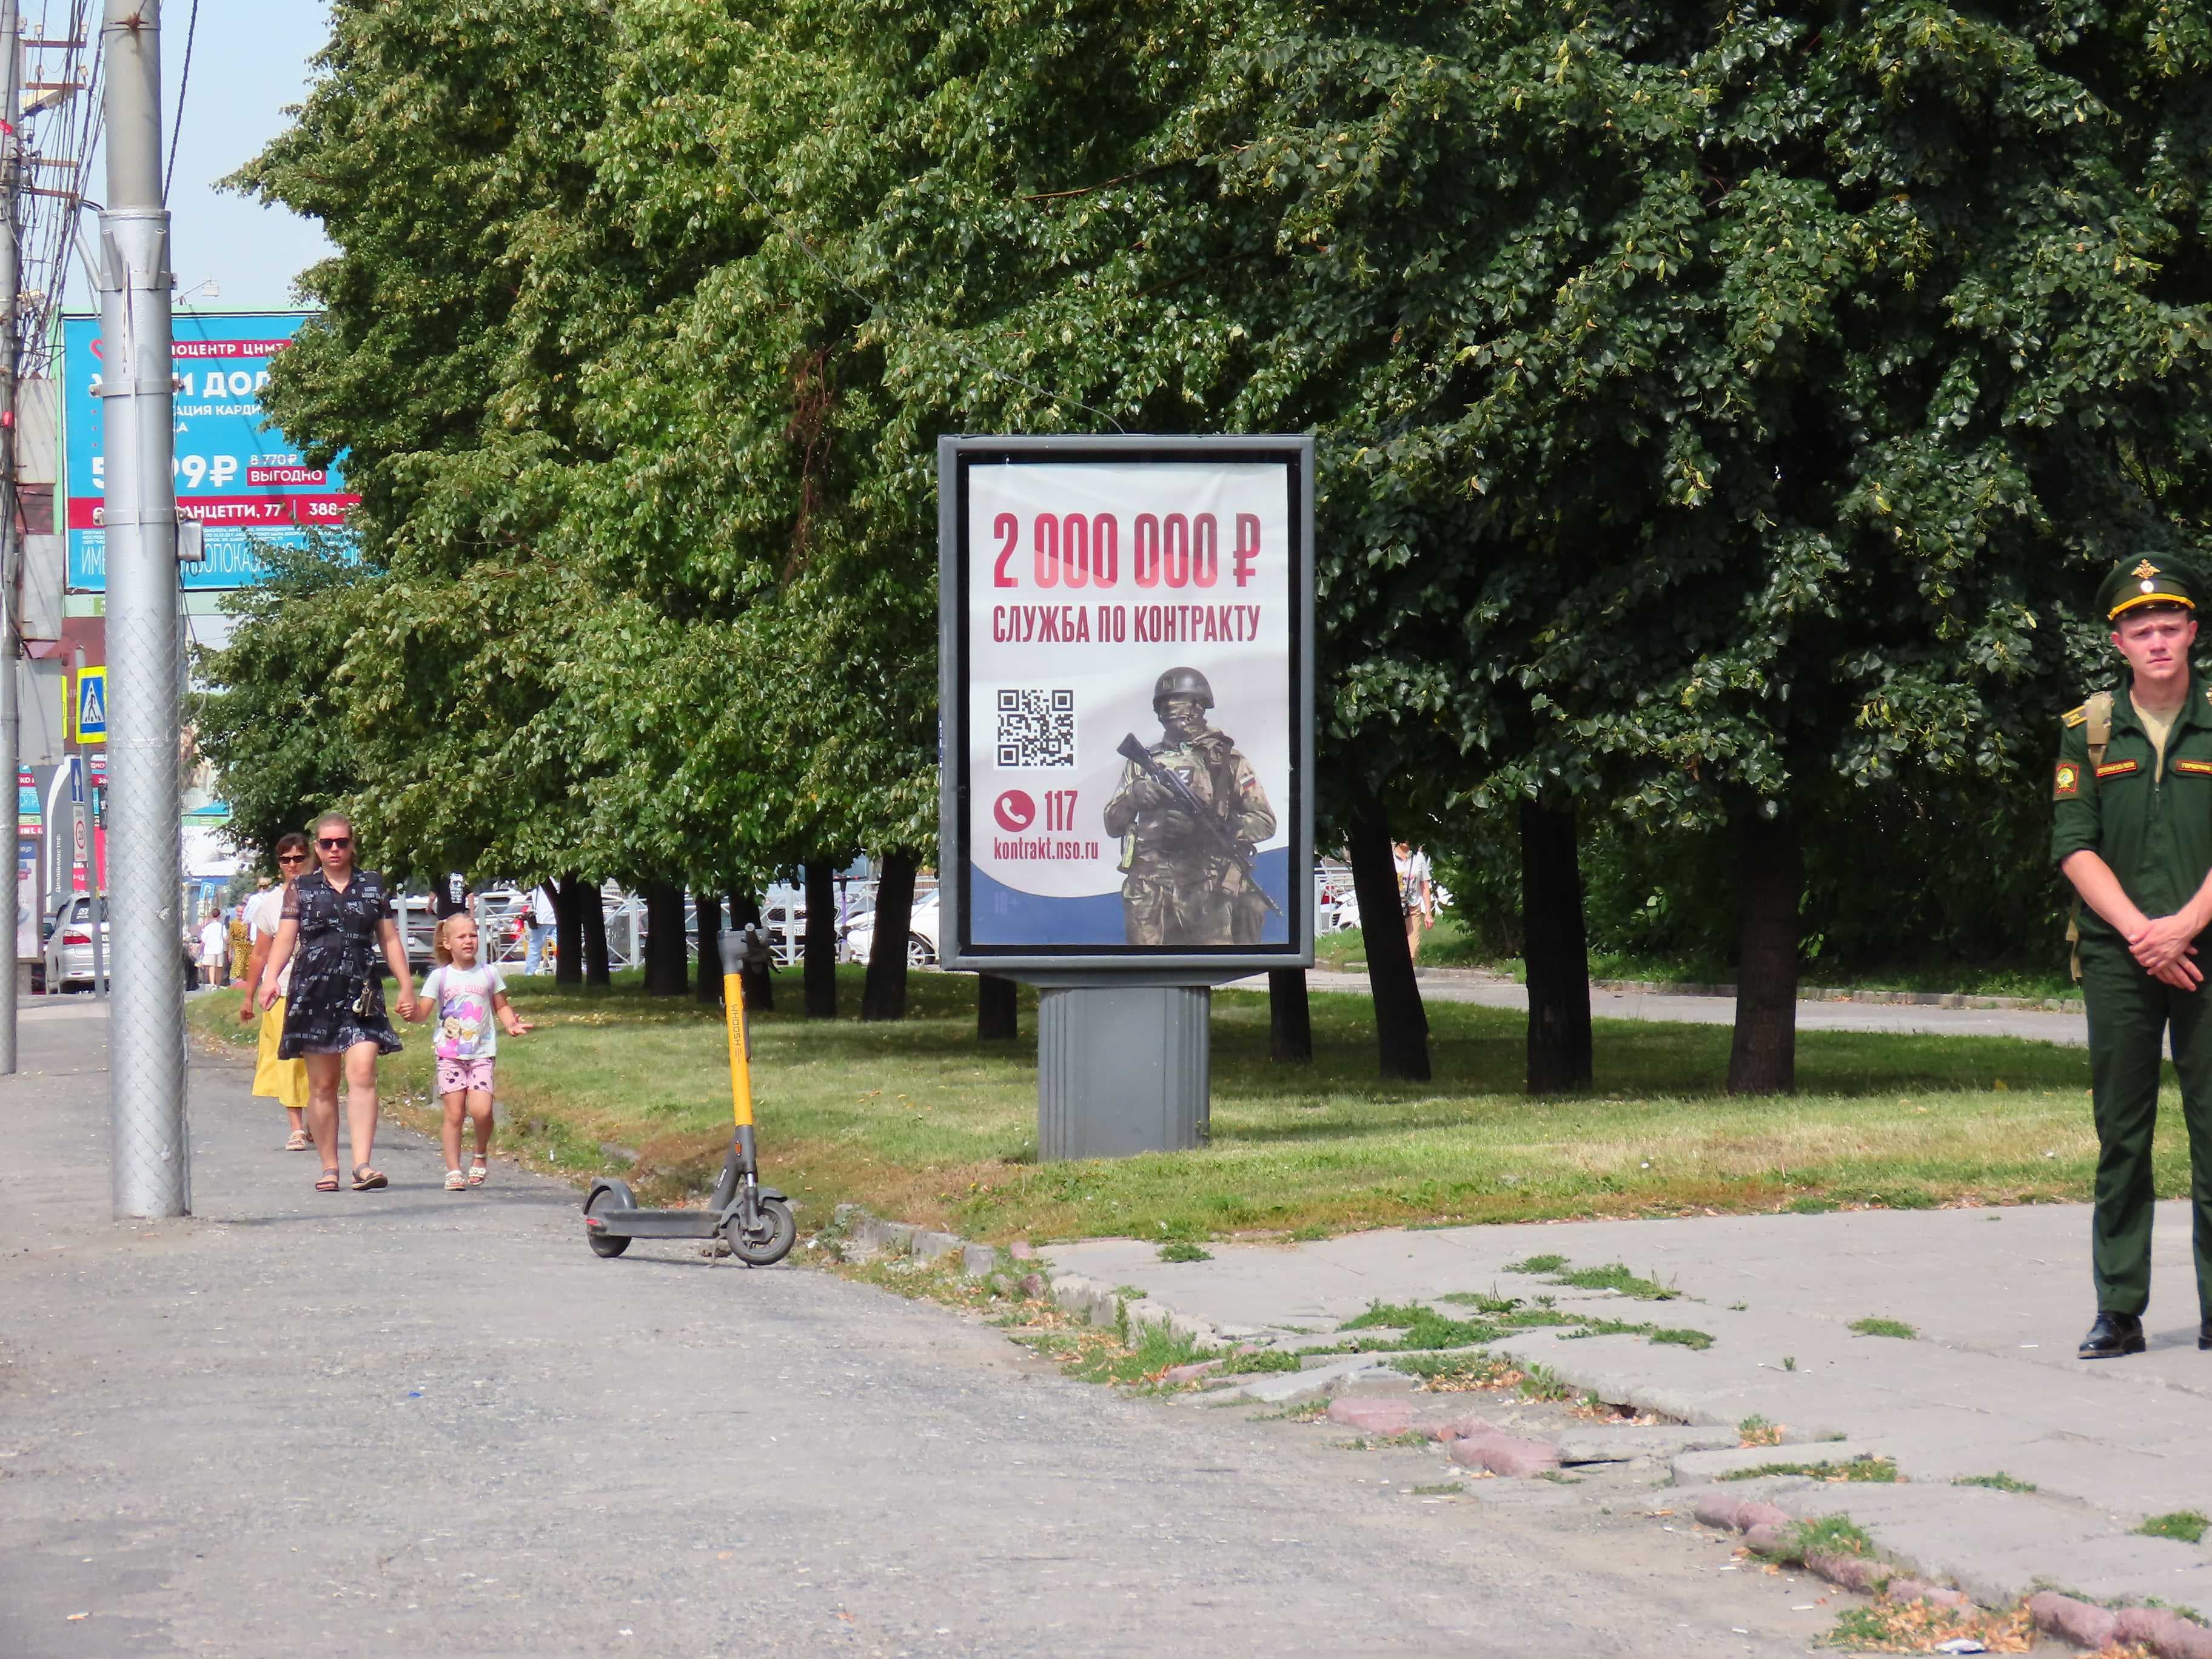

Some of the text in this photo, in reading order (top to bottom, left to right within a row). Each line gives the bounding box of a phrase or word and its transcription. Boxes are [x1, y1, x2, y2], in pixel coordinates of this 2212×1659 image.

[203, 371, 272, 398] ДОЛ
[250, 469, 323, 482] ВЫГОДНО
[184, 504, 260, 518] АНЦЕТТИ,
[264, 504, 281, 517] 77
[994, 512, 1019, 588] 2
[1034, 512, 1118, 589] 000
[1134, 512, 1218, 589] 000
[993, 605, 1261, 643] СЛУЖБА ПО КОНТРАКТУ
[1044, 790, 1078, 831] 117
[994, 837, 1099, 860] kontrakt.nso.ru
[731, 1004, 742, 1046] WHOOSH
